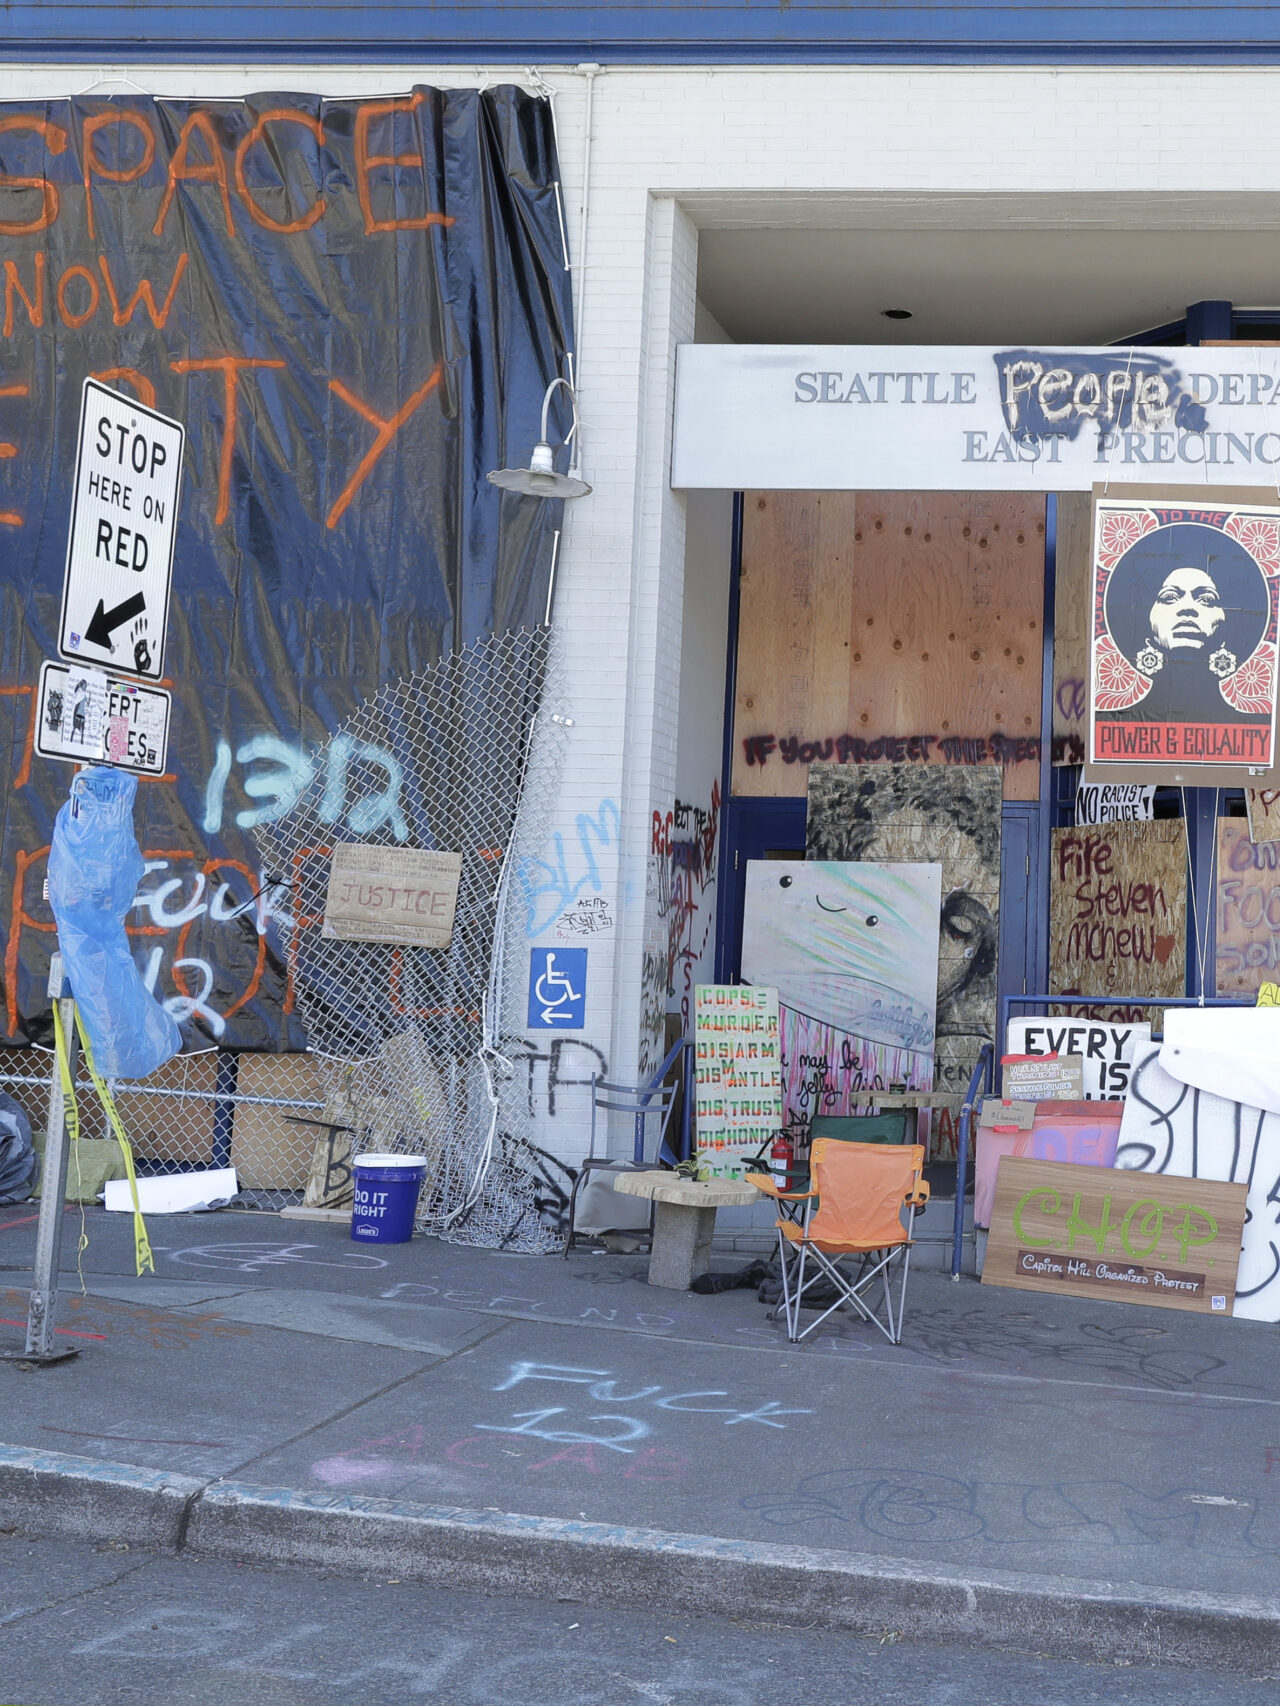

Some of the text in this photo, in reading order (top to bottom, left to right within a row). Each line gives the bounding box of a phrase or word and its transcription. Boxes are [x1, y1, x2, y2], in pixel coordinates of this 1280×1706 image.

[0, 93, 456, 238] SPACE
[3, 252, 189, 338] NOW
[794, 371, 977, 405] SEATTLE
[96, 416, 167, 479] STOP
[962, 430, 1070, 463] EAST
[89, 470, 165, 525] HERE ON
[1156, 509, 1226, 527] TO THE
[96, 517, 149, 573] RED
[1095, 569, 1110, 636] POWER
[1264, 577, 1280, 641] PEOPLE
[743, 735, 834, 767] IF YOU
[1101, 725, 1270, 757] POWER & EQUALITY
[204, 733, 410, 843] 1312
[1076, 785, 1147, 825] NO RACIST
[518, 797, 620, 939] BLM
[1059, 835, 1114, 882] Fire
[340, 883, 450, 916] JUSTICE
[1075, 879, 1168, 919] Steven
[702, 988, 752, 1006] COPS
[698, 1014, 778, 1033] MURDER
[697, 1042, 775, 1059] DISARM
[800, 1040, 863, 1075] may be
[1025, 1027, 1132, 1060] EVERY
[695, 1059, 781, 1088] DISMANTLE
[797, 1073, 842, 1107] jelly
[1100, 1062, 1131, 1091] IS
[697, 1100, 782, 1119] DISTRUST
[353, 1203, 387, 1218] RIGHT
[354, 1190, 389, 1205] DO IT
[492, 1361, 815, 1429] FUCK
[473, 1406, 652, 1454] 12
